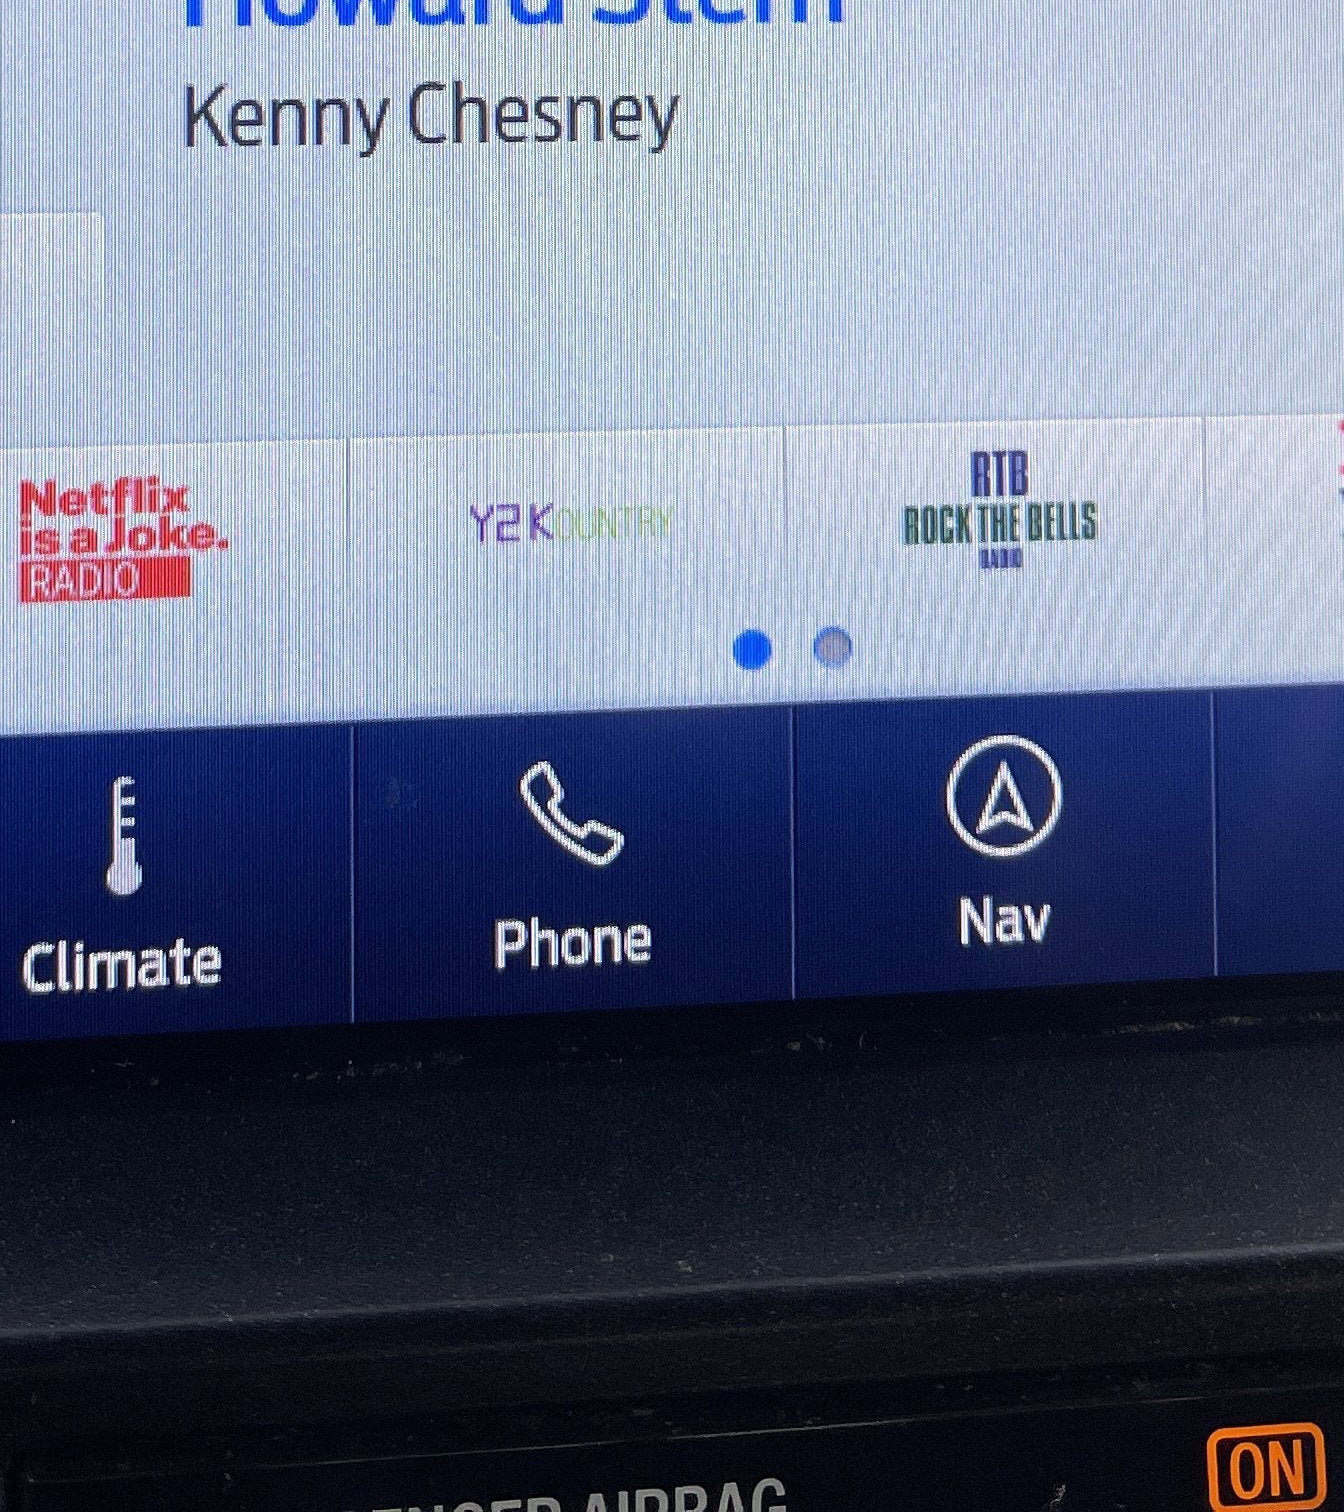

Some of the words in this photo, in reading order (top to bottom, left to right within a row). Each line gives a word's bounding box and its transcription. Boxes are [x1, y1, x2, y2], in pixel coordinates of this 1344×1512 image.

[184, 83, 391, 158] Kenny
[409, 81, 681, 154] Chesney
[20, 474, 191, 517] Netflix
[970, 449, 1029, 497] RTB
[904, 504, 972, 545] ROCK
[976, 502, 1021, 543] THE
[1027, 500, 1098, 542] BELLS
[30, 560, 140, 601] RADIO
[494, 917, 653, 971] Phone
[958, 895, 1052, 947] Nav
[22, 937, 223, 996] Climate
[1229, 1438, 1305, 1500] ON
